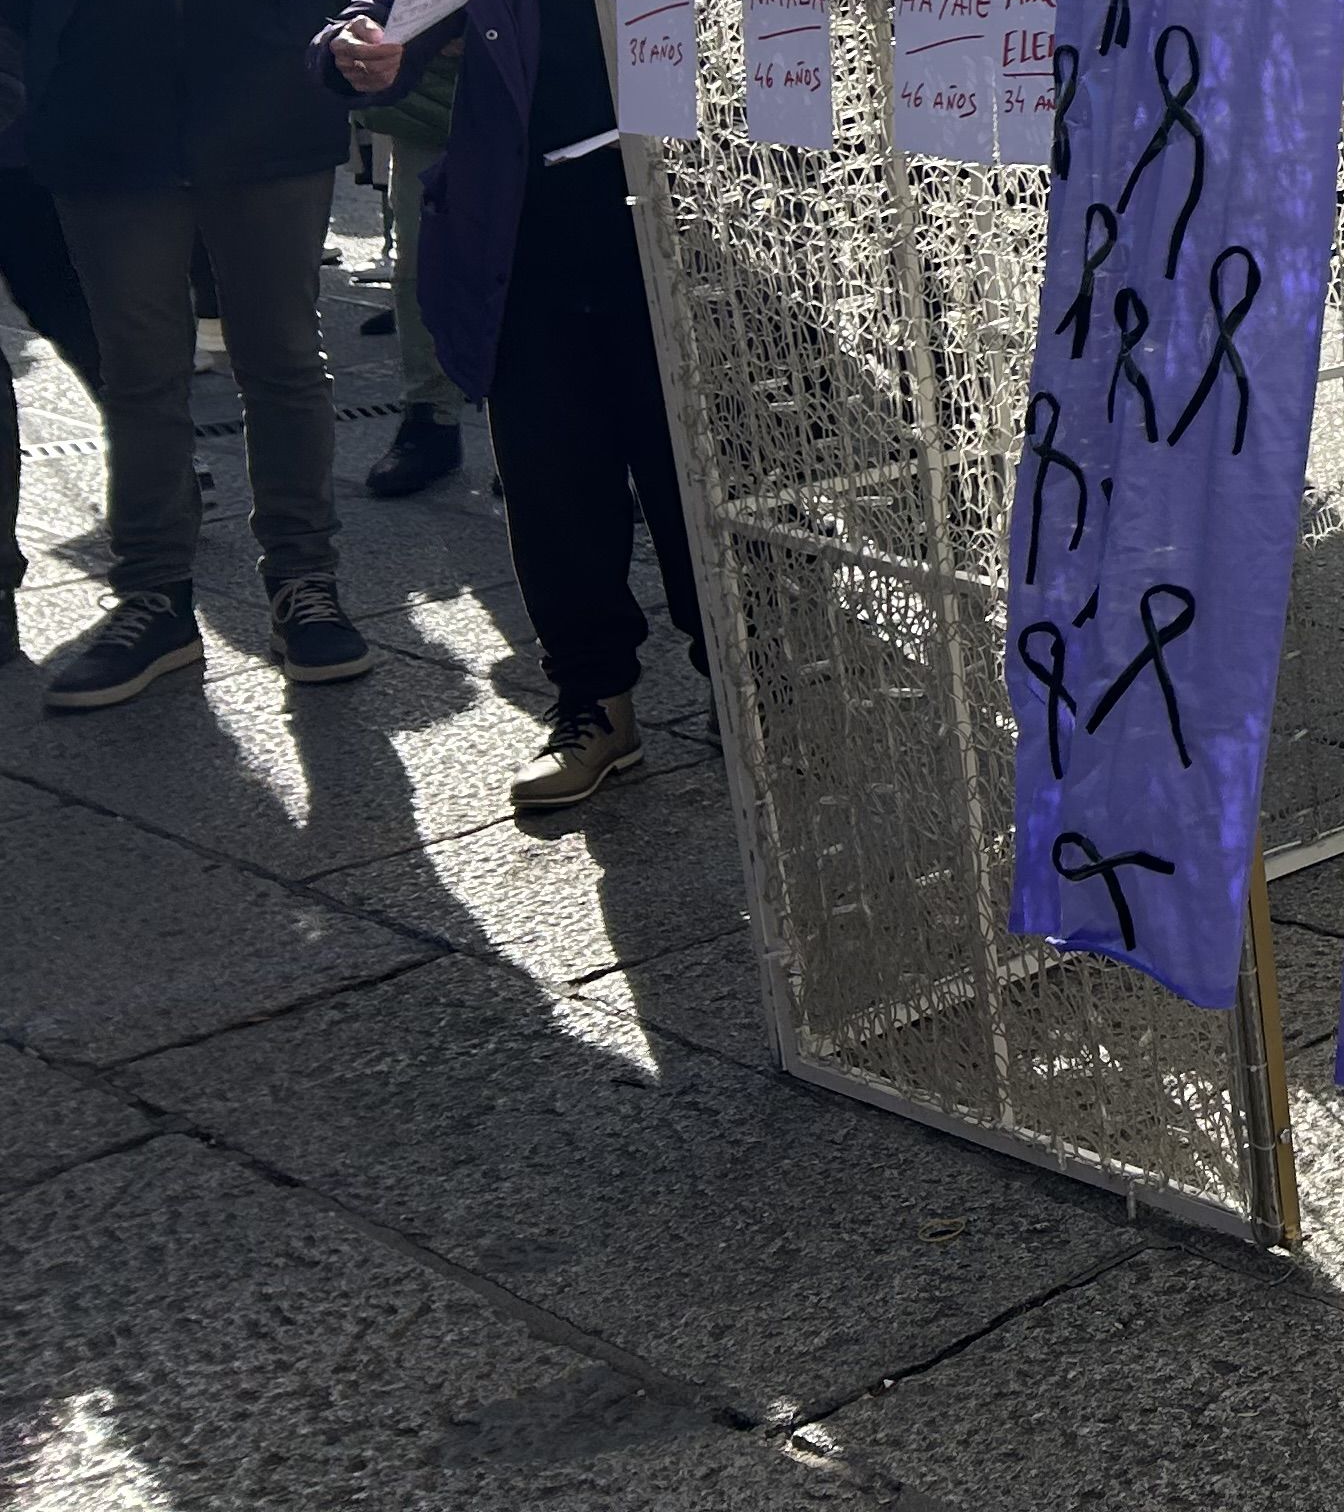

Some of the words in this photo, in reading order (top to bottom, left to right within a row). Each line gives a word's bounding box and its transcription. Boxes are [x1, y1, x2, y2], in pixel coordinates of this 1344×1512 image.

[630, 37, 647, 65] 38
[650, 36, 683, 66] AÑOS
[755, 63, 774, 88] 46
[784, 61, 821, 91] AÑOS
[901, 82, 925, 108] 46
[932, 85, 977, 118] AÑOS
[1004, 86, 1024, 113] 34
